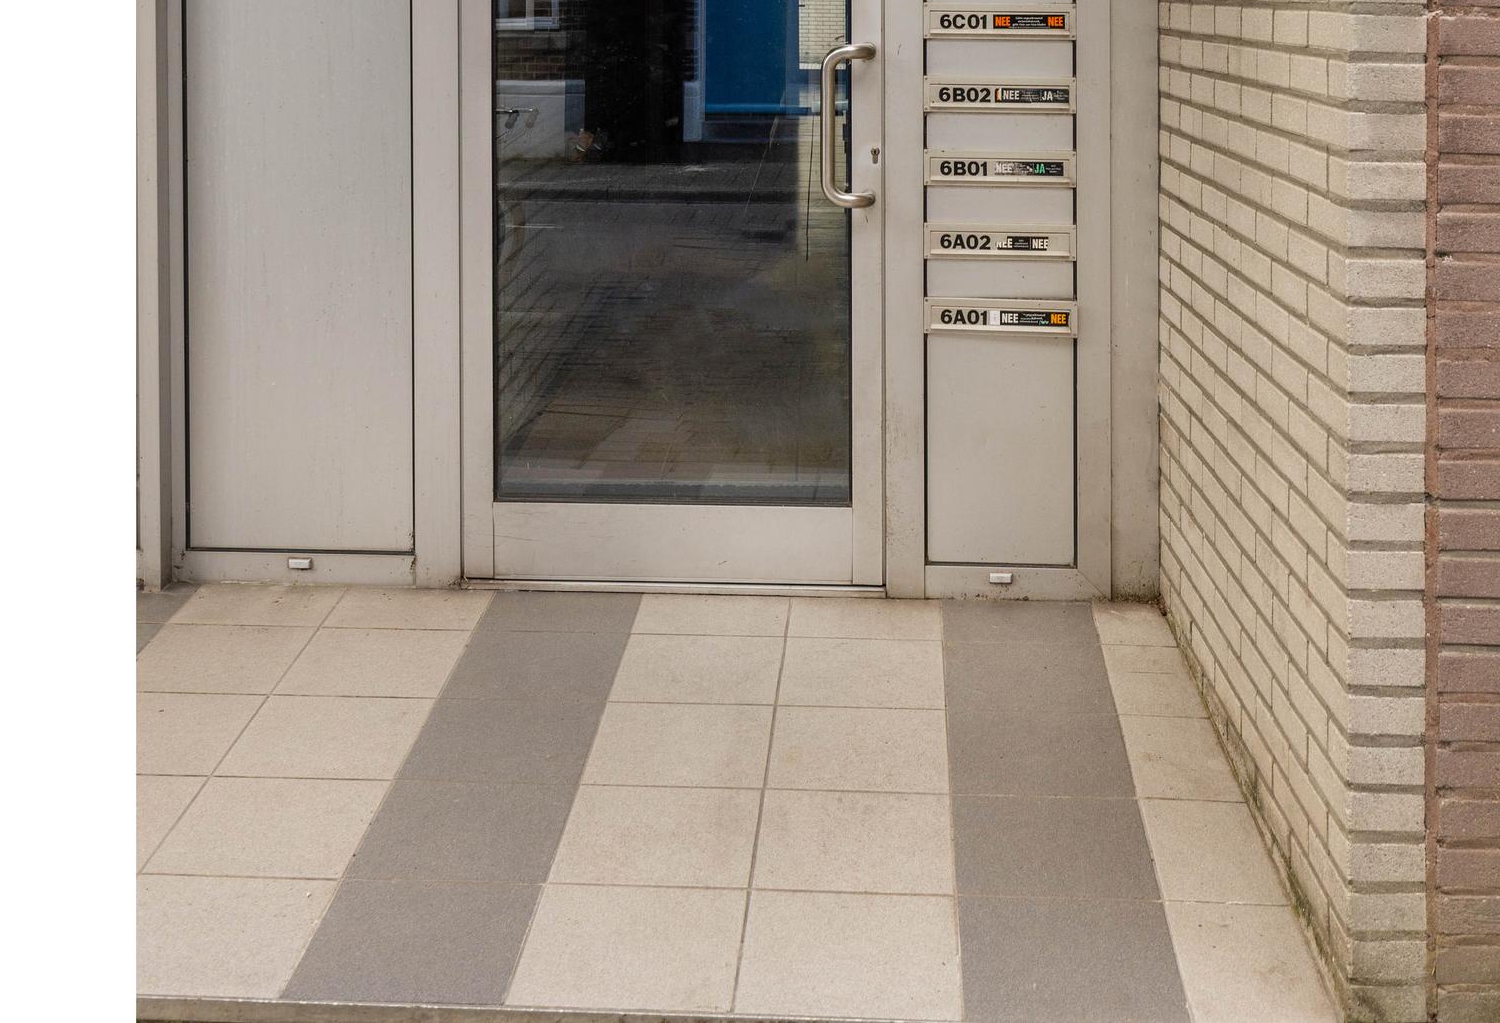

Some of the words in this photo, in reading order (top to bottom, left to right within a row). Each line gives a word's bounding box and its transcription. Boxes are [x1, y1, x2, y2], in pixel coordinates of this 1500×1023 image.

[939, 14, 987, 29] 6C01
[995, 16, 1011, 27] NEE
[1047, 16, 1063, 27] NEE
[939, 87, 991, 103] 6B02
[1003, 90, 1020, 100] NEE
[1041, 90, 1053, 101] JA
[940, 161, 987, 176] 6B01
[995, 162, 1013, 174] NEE
[1034, 163, 1046, 174] JA
[940, 234, 991, 250] 6A02
[1032, 238, 1048, 249] NEE
[940, 309, 987, 325] 6A01
[1001, 313, 1018, 324] NEE
[1050, 313, 1066, 324] NEE
